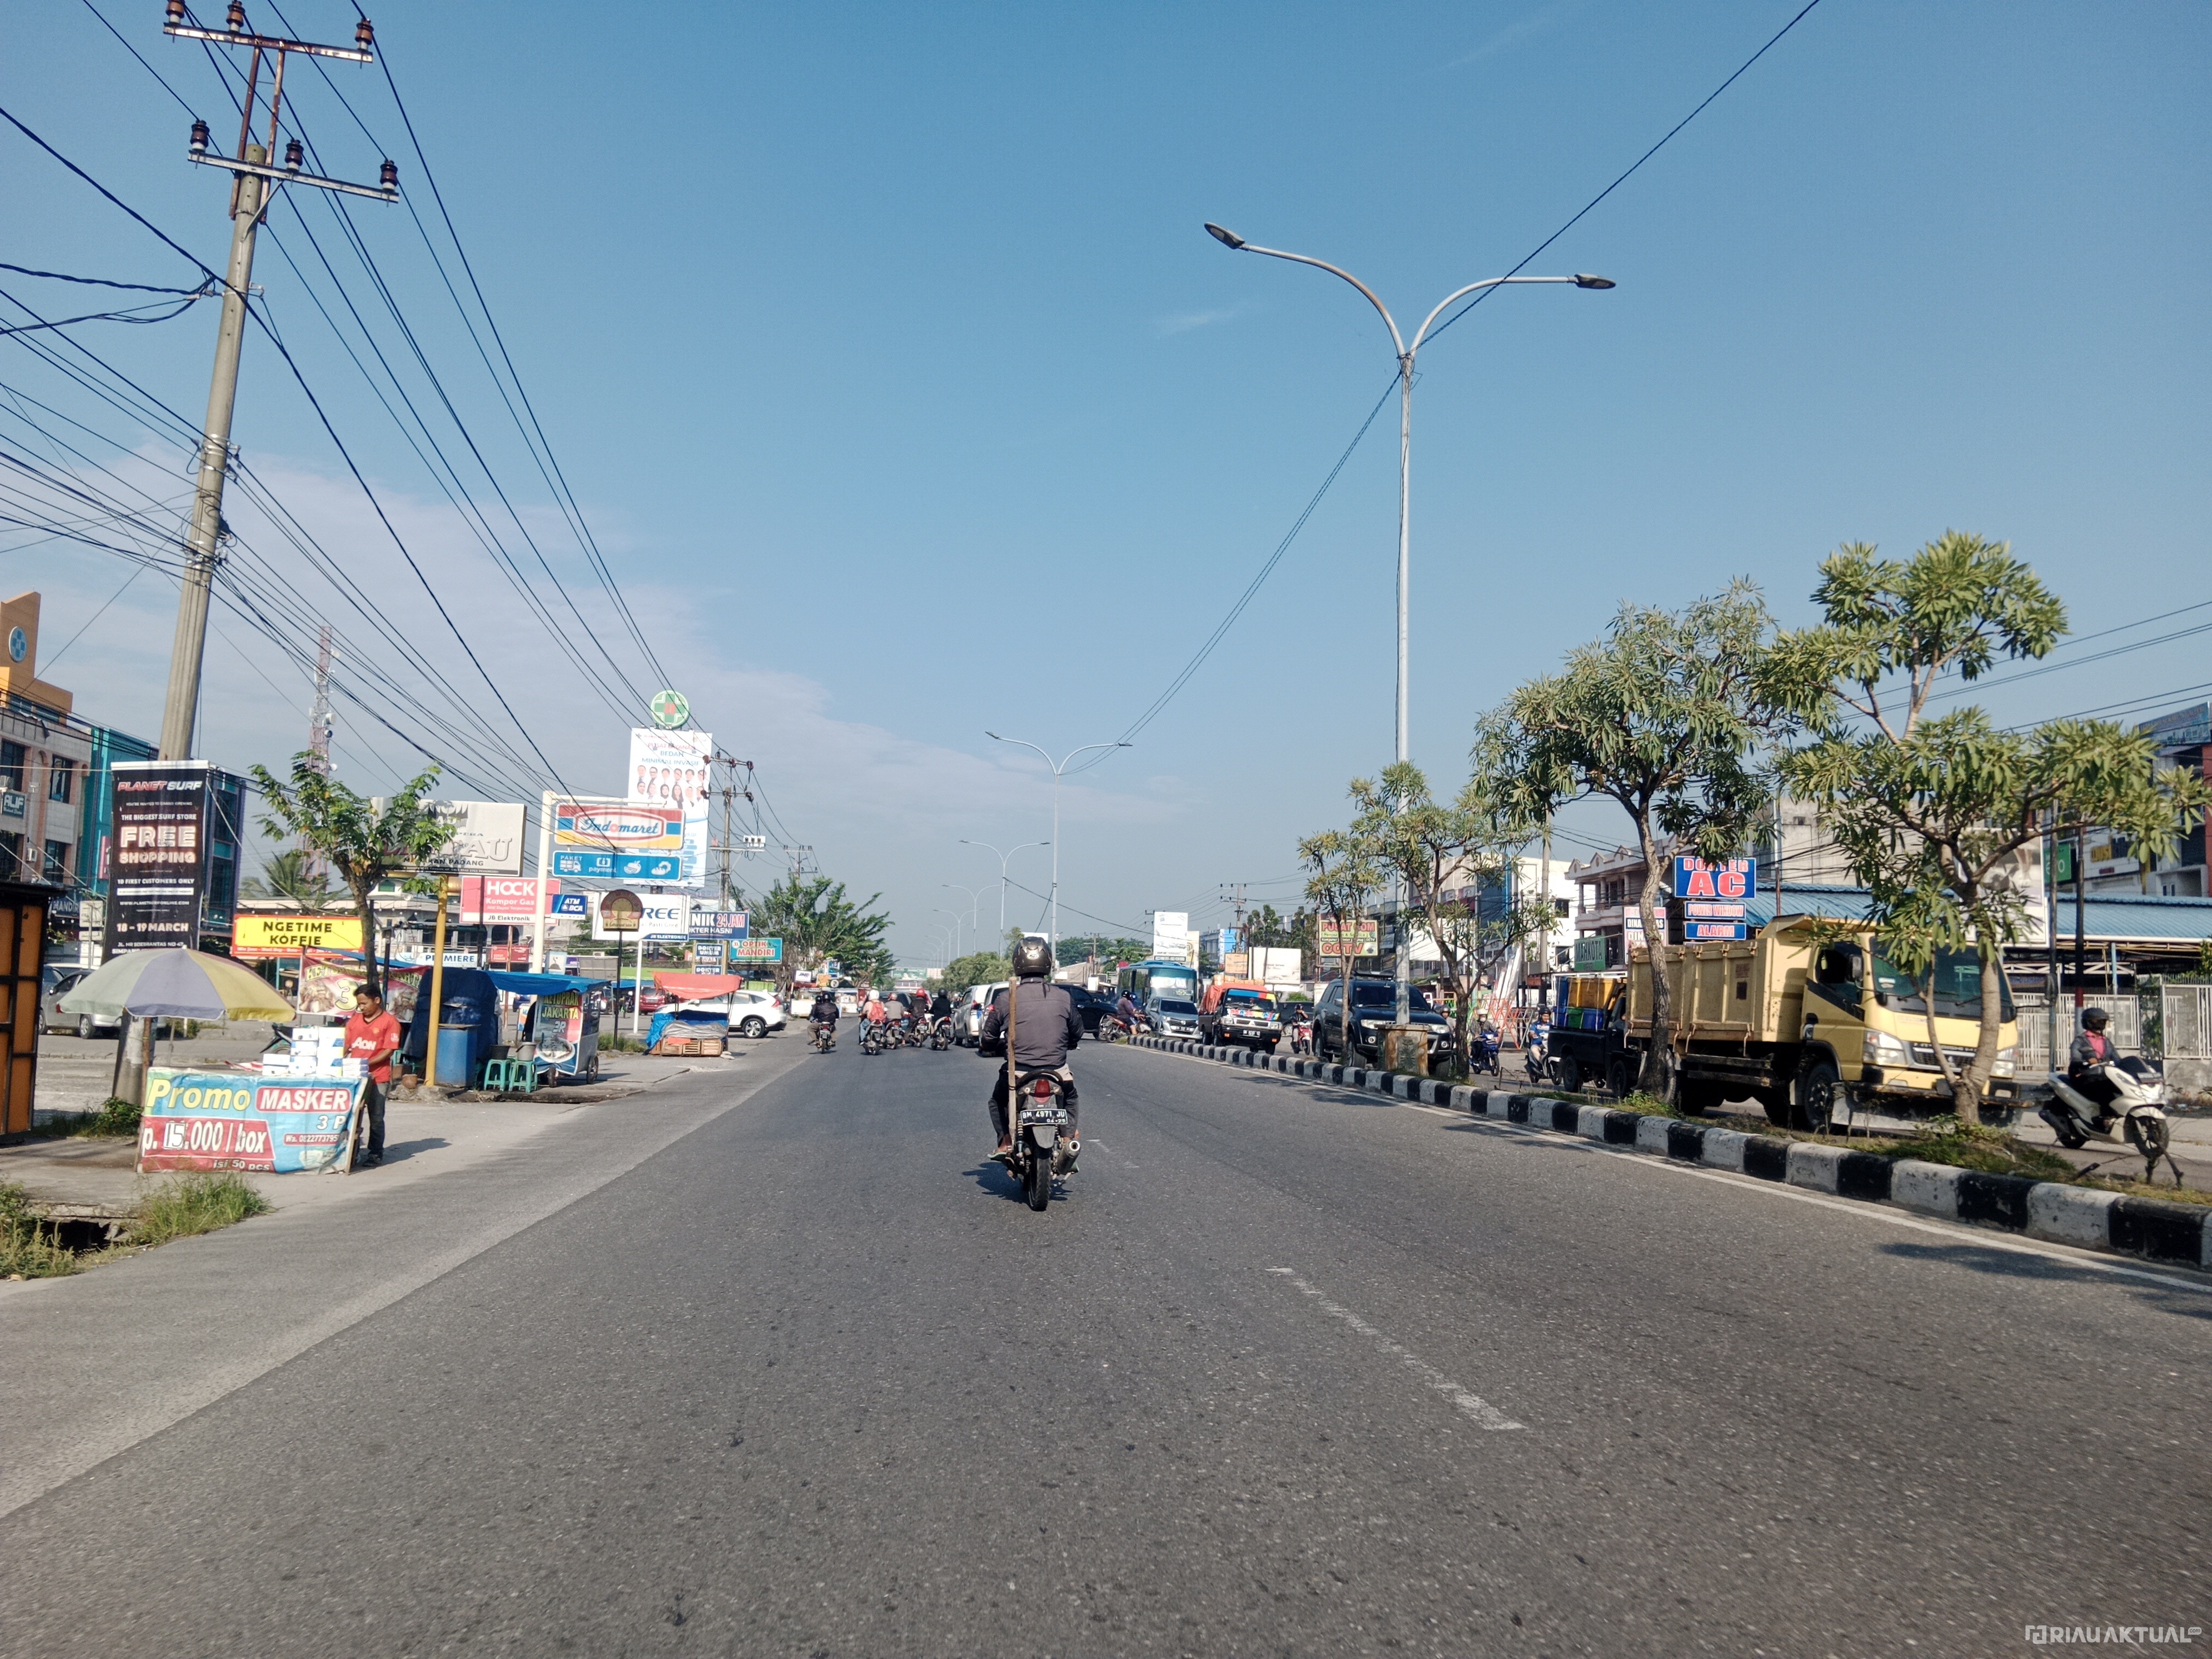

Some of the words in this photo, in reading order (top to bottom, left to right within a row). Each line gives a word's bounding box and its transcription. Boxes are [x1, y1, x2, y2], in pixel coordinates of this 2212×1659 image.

[118, 780, 168, 792] PLANET
[167, 781, 203, 791] SURF
[3, 794, 25, 809] ALIF
[581, 818, 659, 834] Indomaret
[120, 826, 196, 847] FREE
[119, 852, 196, 863] SHOPPING
[487, 880, 536, 896] HOCK
[1686, 871, 1746, 897] AC
[53, 902, 80, 912] MANDIR
[486, 898, 518, 908] Kompor
[641, 908, 681, 919] REE
[1688, 904, 1713, 916] POWER
[1713, 904, 1744, 917] WINDOW
[117, 923, 128, 932] 18
[136, 923, 147, 932] 19
[148, 923, 189, 931] MARCH
[263, 921, 332, 933] NGETIME
[716, 914, 728, 927] 24
[728, 914, 745, 928] JAM
[1354, 922, 1375, 932] OM
[1696, 924, 1735, 937] ALARM
[269, 935, 321, 946] KOFFIE
[736, 949, 775, 957] MANDIRI
[1322, 942, 1365, 954] CCTV
[1576, 940, 1603, 962] MAHKOTA
[426, 954, 474, 963] PMIERE
[542, 1006, 578, 1020] JAKARTA
[352, 1037, 377, 1051] AON
[146, 1078, 252, 1111] Promo
[260, 1089, 348, 1111] MASKER
[317, 1115, 329, 1130] 3
[235, 1124, 268, 1154] box
[214, 1160, 228, 1169] isi
[232, 1160, 246, 1169] 50
